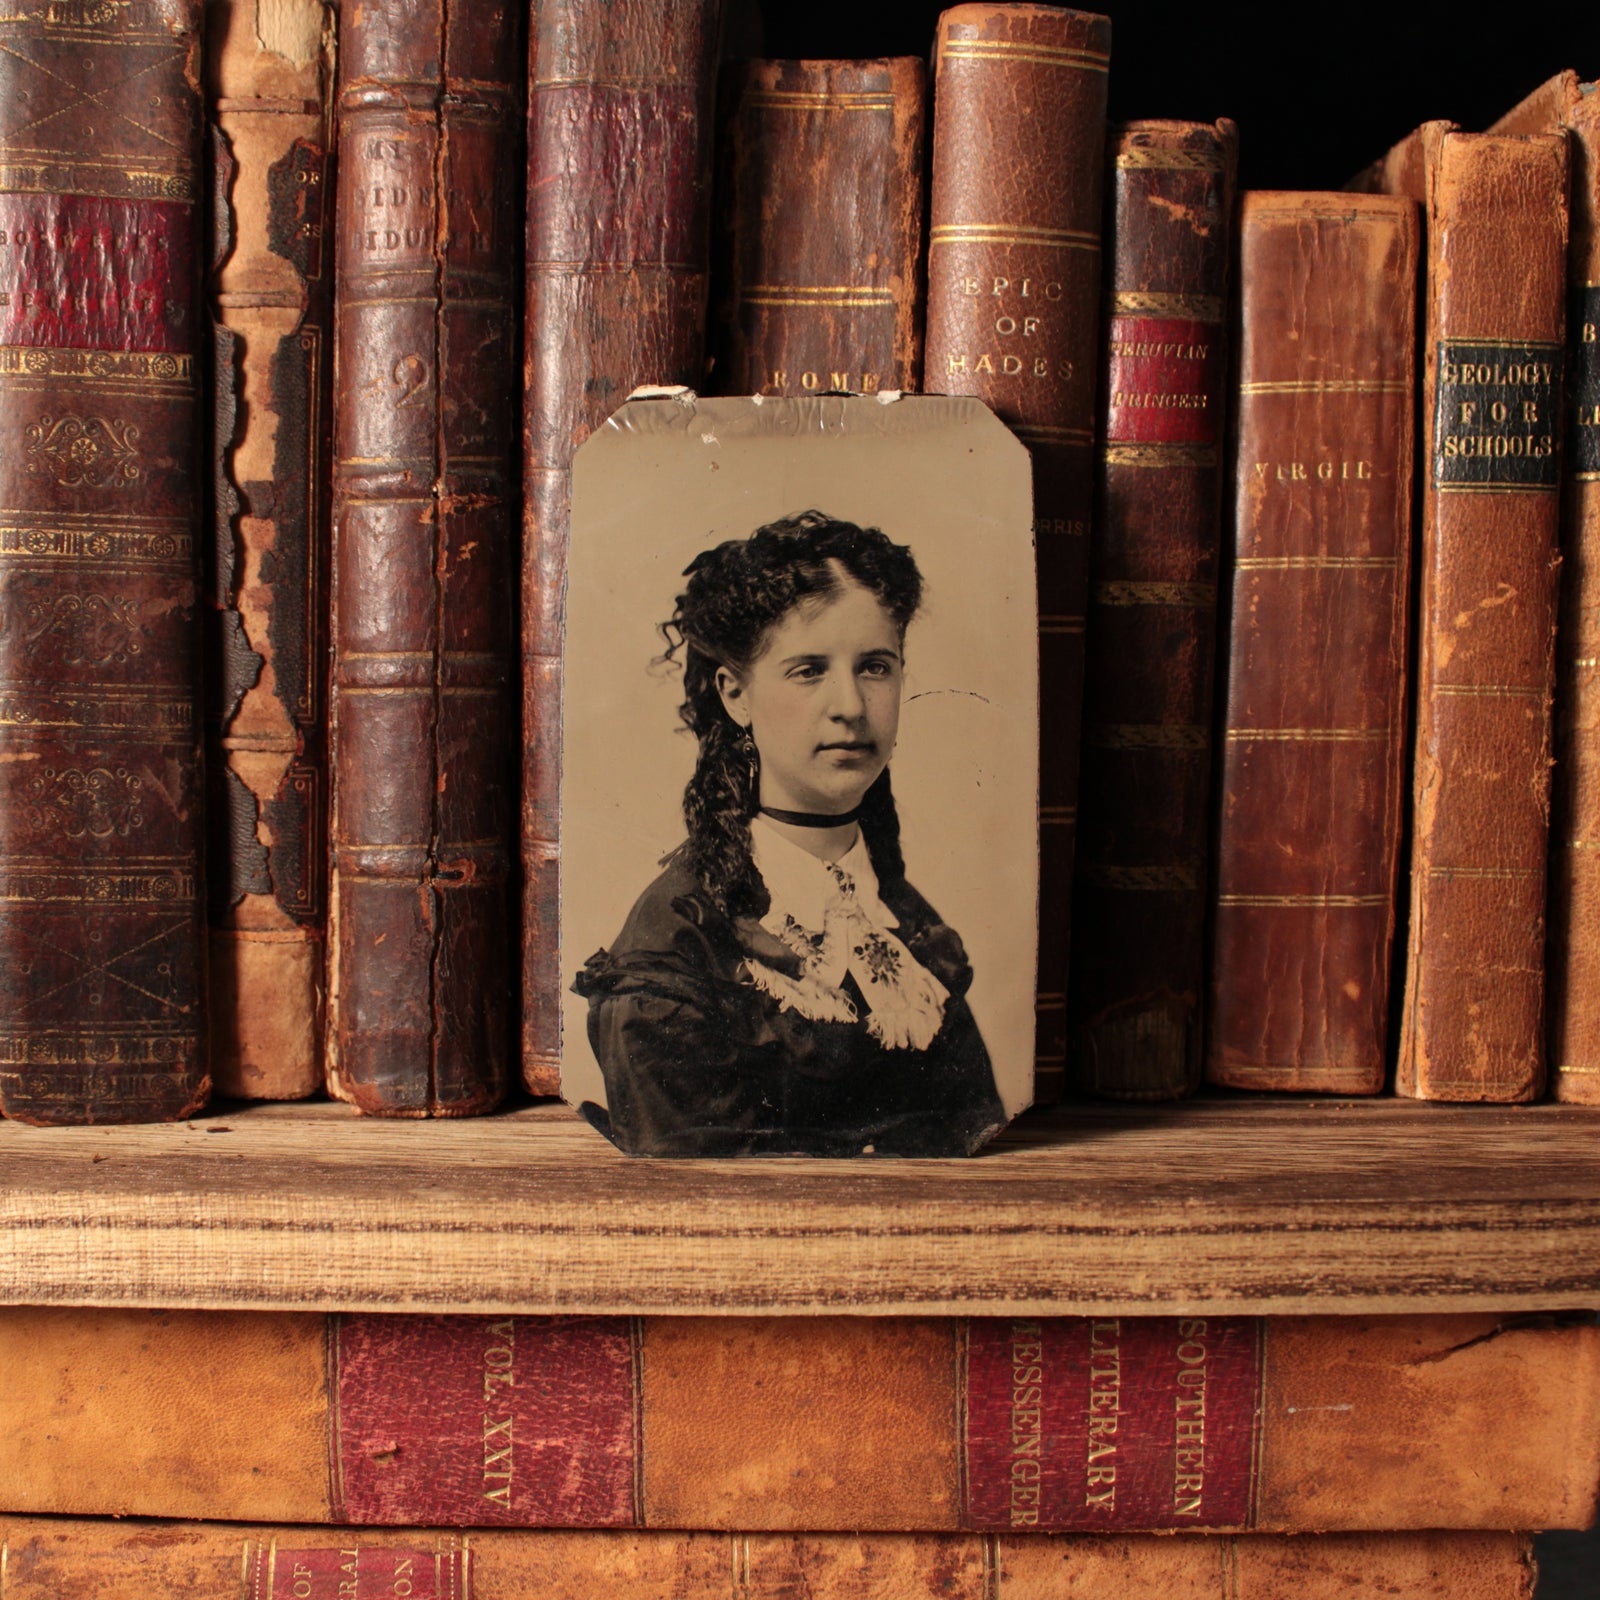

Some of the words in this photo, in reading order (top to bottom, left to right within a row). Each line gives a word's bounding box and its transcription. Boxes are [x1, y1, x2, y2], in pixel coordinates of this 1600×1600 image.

[963, 276, 1062, 300] EPIC
[995, 316, 1040, 336] OF
[1110, 342, 1208, 359] PERUVIAN
[947, 353, 1074, 381] HADES
[1441, 363, 1552, 386] GEOLOGY
[393, 355, 430, 408] 2
[772, 370, 880, 392] ROME
[1113, 391, 1208, 409] PRINCESS
[1458, 401, 1539, 424] FOR
[1444, 435, 1553, 458] SCHOOLS
[1255, 461, 1372, 481] VIRGIL
[1037, 518, 1084, 536] RRIS
[483, 1320, 515, 1401] VOL.
[1086, 1319, 1121, 1513] LITERARY
[1174, 1318, 1208, 1518] SOUTHERN
[483, 1413, 513, 1510] XXIV
[292, 1562, 312, 1598] OF
[339, 1543, 359, 1600] RAL
[393, 1556, 413, 1600] ON
